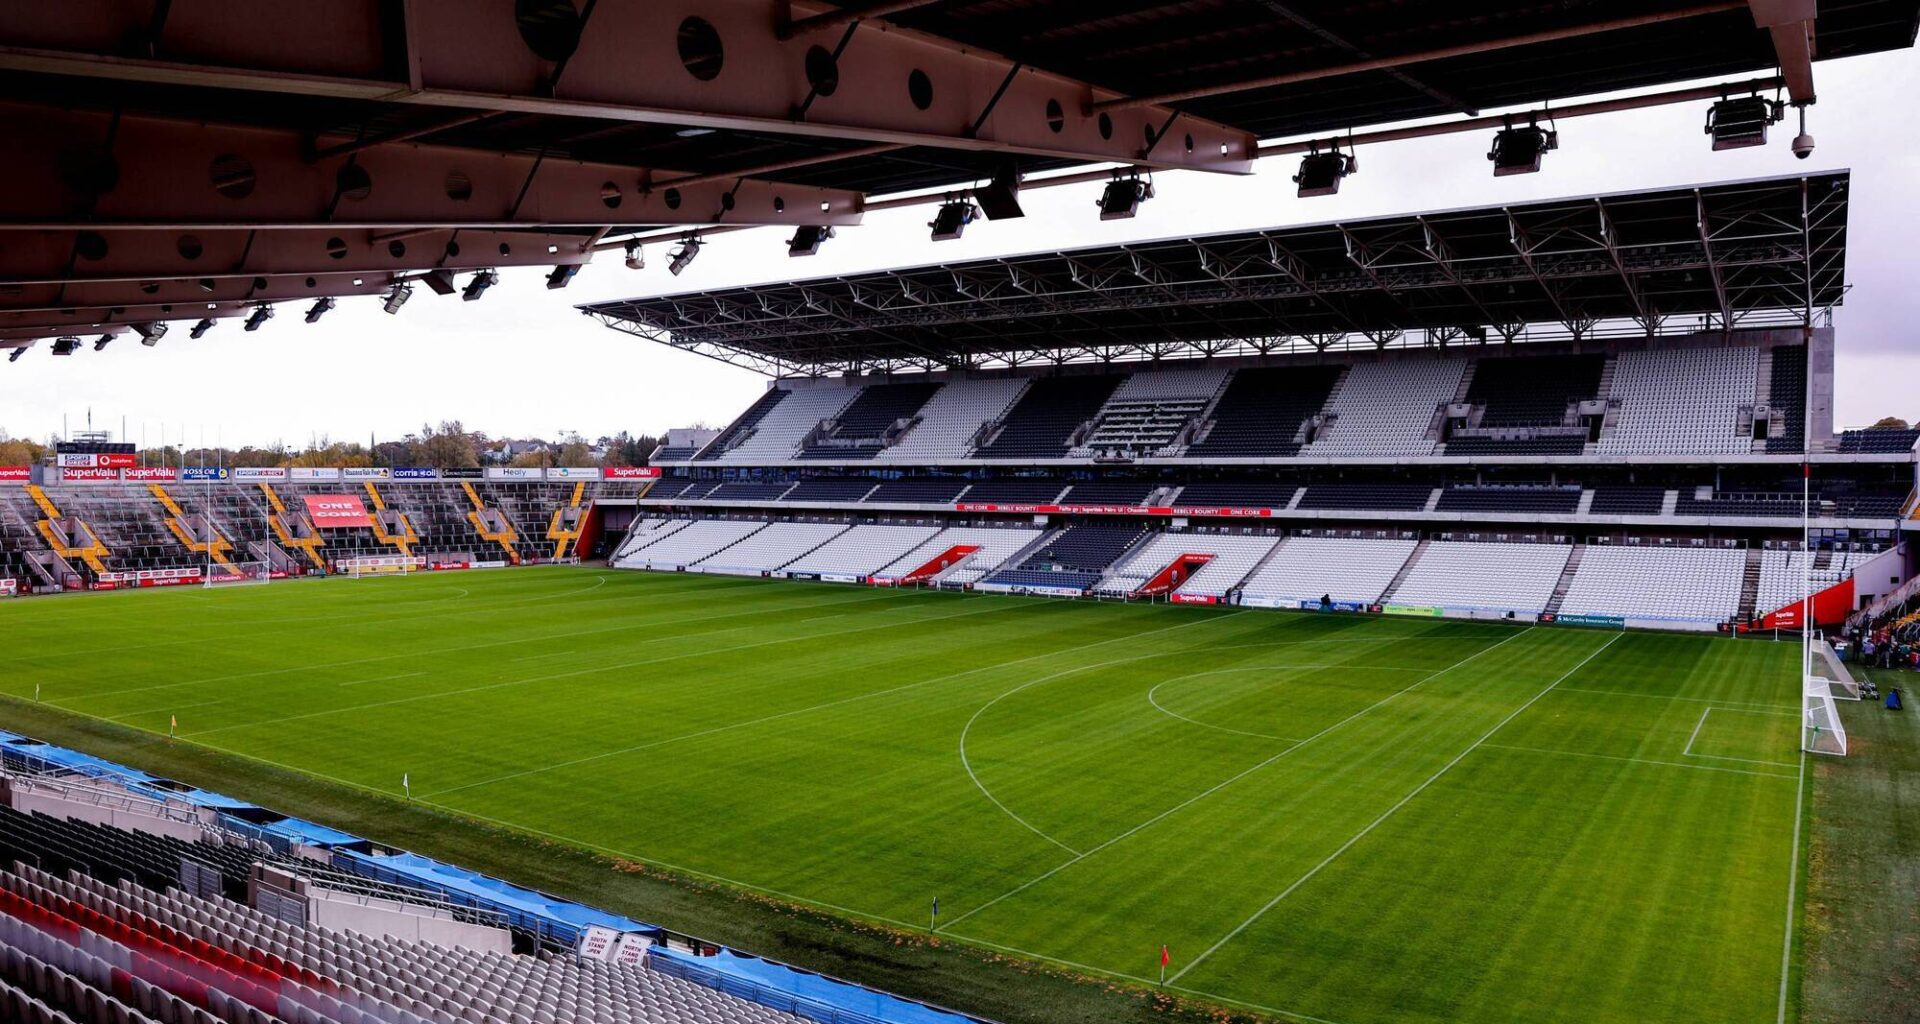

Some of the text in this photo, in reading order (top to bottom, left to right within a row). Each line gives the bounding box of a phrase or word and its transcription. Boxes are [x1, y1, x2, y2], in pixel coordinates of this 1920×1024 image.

[0, 469, 30, 477] uperValu
[64, 468, 117, 479] SuperValu
[125, 468, 175, 478] SuperValu
[426, 468, 436, 476] oil
[614, 468, 651, 477] SuperValu
[1180, 594, 1208, 602] SuperValu
[590, 936, 608, 944] SOUTH
[587, 942, 605, 950] STAND
[623, 944, 642, 952] NORTH
[621, 950, 639, 958] STAND
